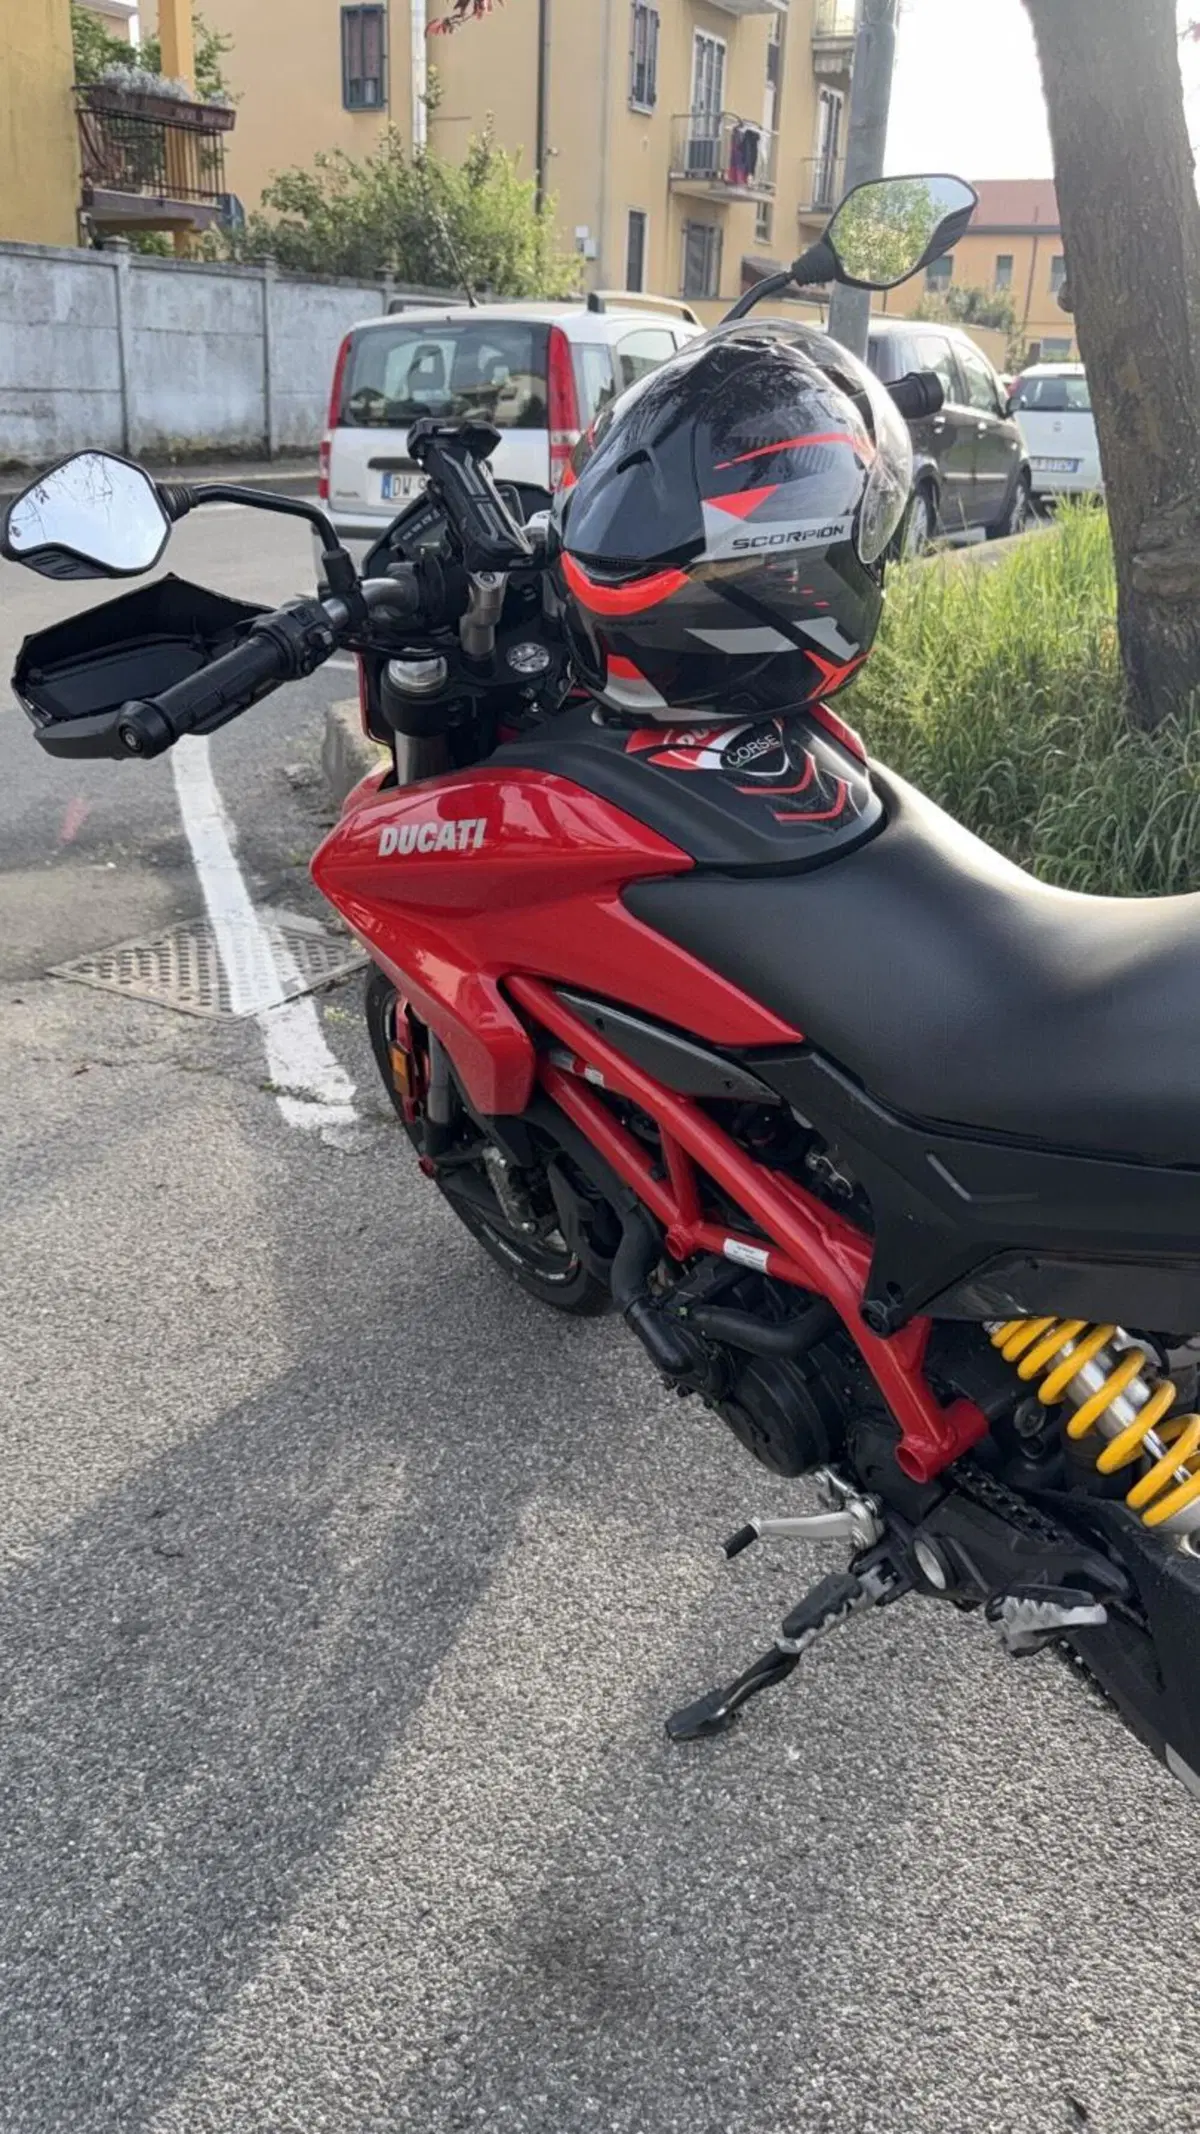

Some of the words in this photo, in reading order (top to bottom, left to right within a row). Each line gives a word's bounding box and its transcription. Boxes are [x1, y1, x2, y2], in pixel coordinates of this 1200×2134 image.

[731, 525, 845, 550] SCORPION
[726, 734, 780, 765] CORSE
[378, 817, 488, 857] DUCATI
